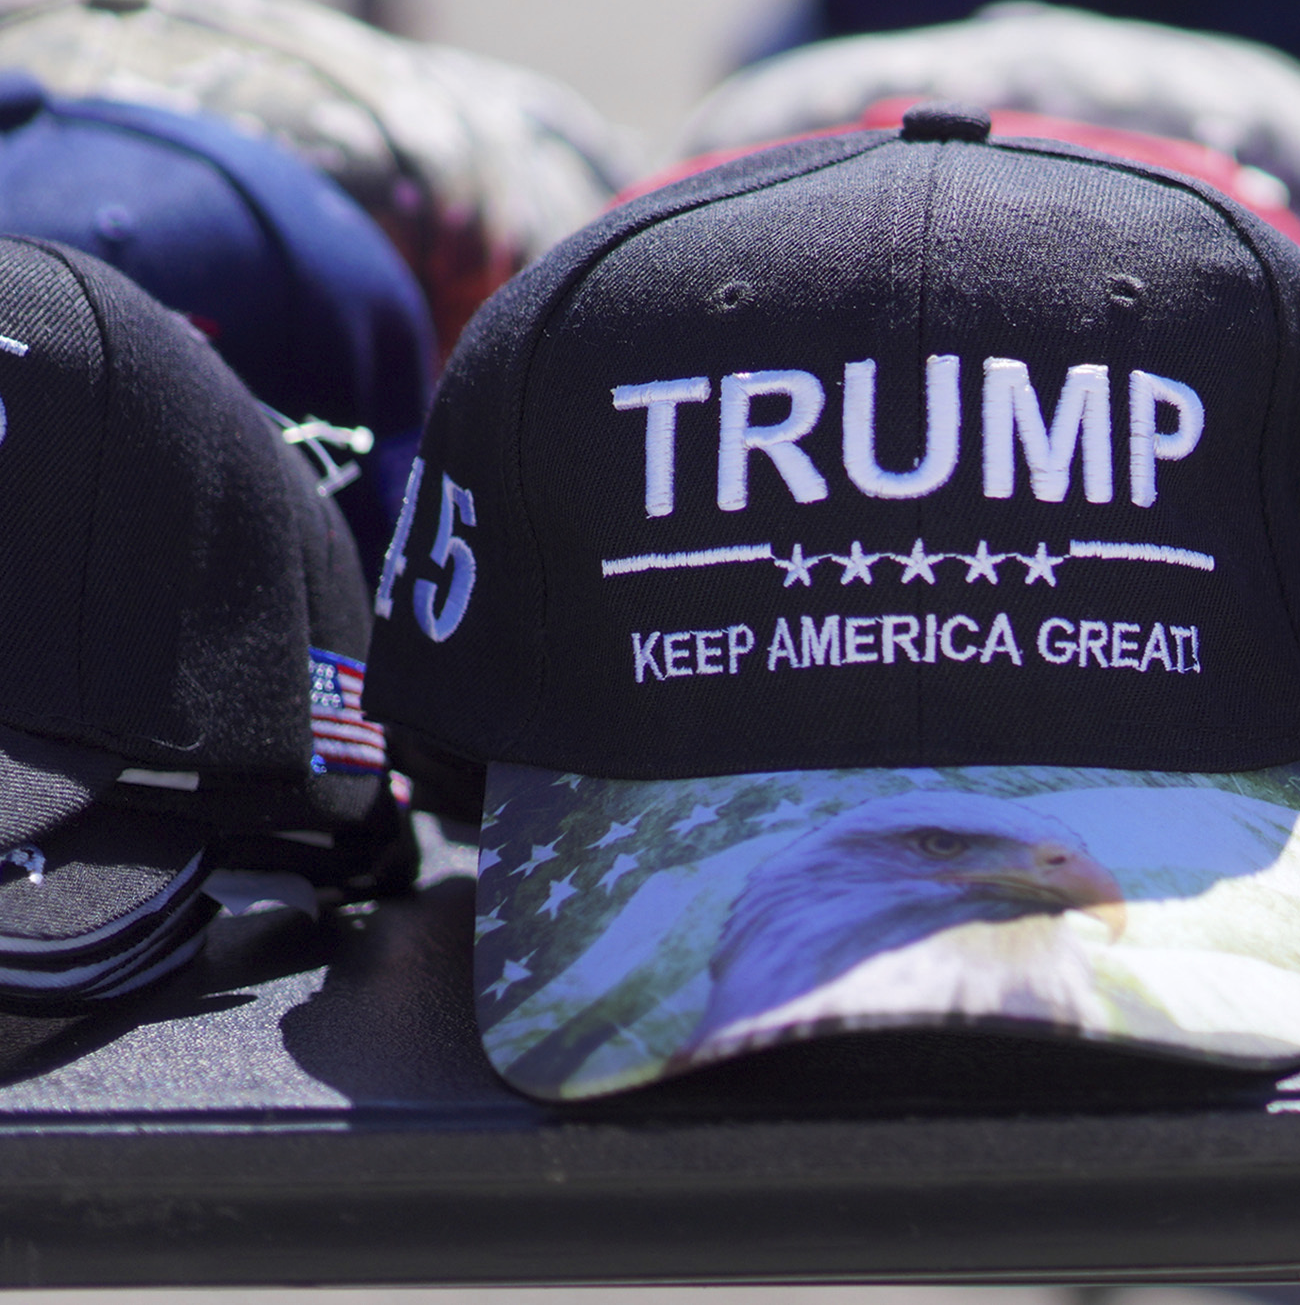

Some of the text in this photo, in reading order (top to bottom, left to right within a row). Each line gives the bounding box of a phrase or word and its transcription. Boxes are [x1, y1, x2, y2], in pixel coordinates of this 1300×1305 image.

[611, 355, 1205, 518] TRUMP
[631, 623, 756, 683] KEEP
[767, 613, 1022, 672] AMERICA
